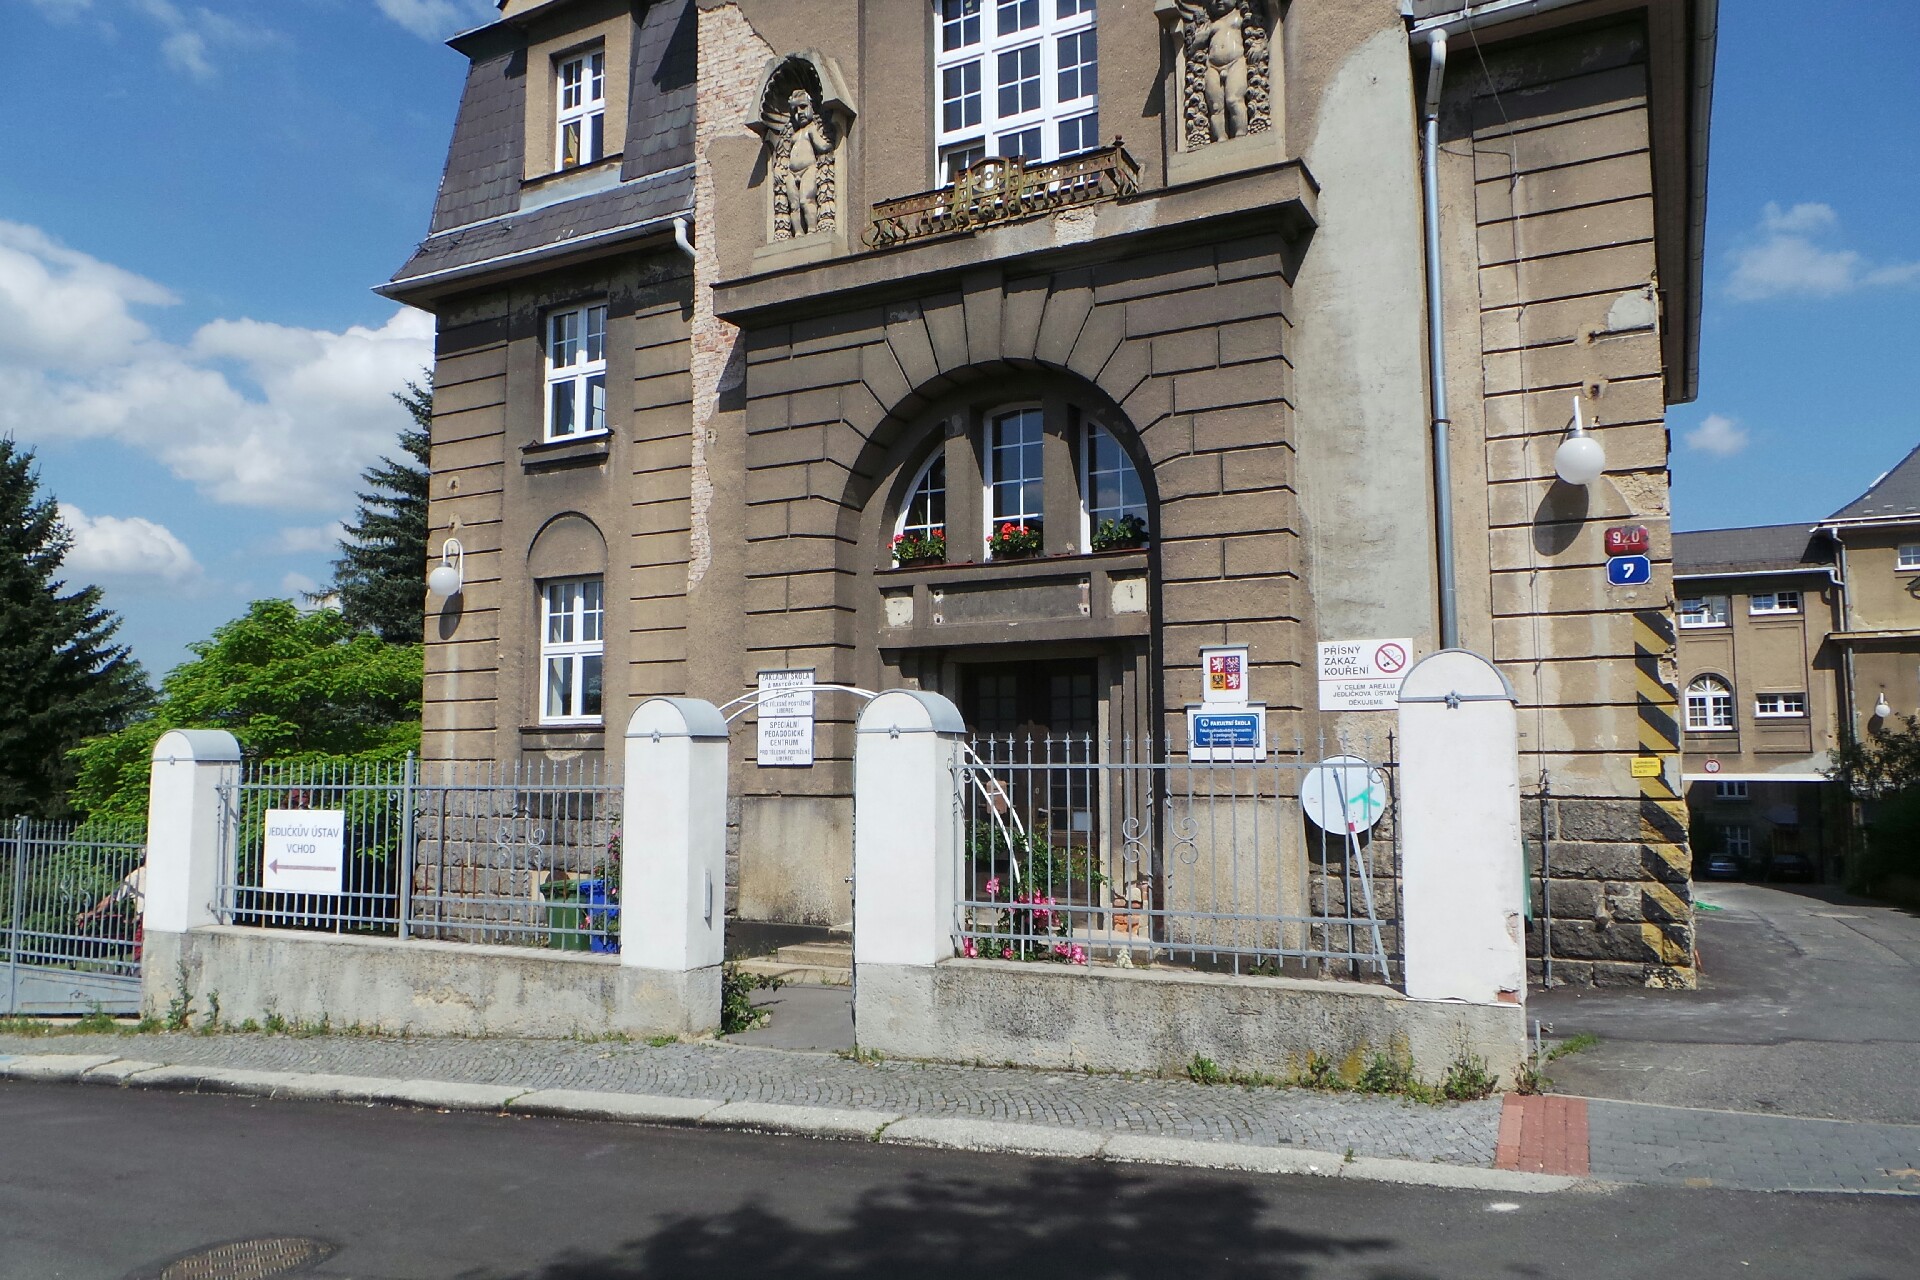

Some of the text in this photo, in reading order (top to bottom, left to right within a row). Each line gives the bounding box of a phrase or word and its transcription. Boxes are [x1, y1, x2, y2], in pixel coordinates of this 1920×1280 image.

[1612, 530, 1640, 544] 920
[1622, 563, 1635, 579] 7
[1324, 645, 1360, 654] PŘÍSNÝ
[1324, 655, 1356, 665] ZÁKAZ
[1324, 665, 1368, 675] KOUŘENÍ
[268, 824, 339, 838] JEDLIČKŮV ÚSTAV
[287, 844, 316, 853] VCHOD
